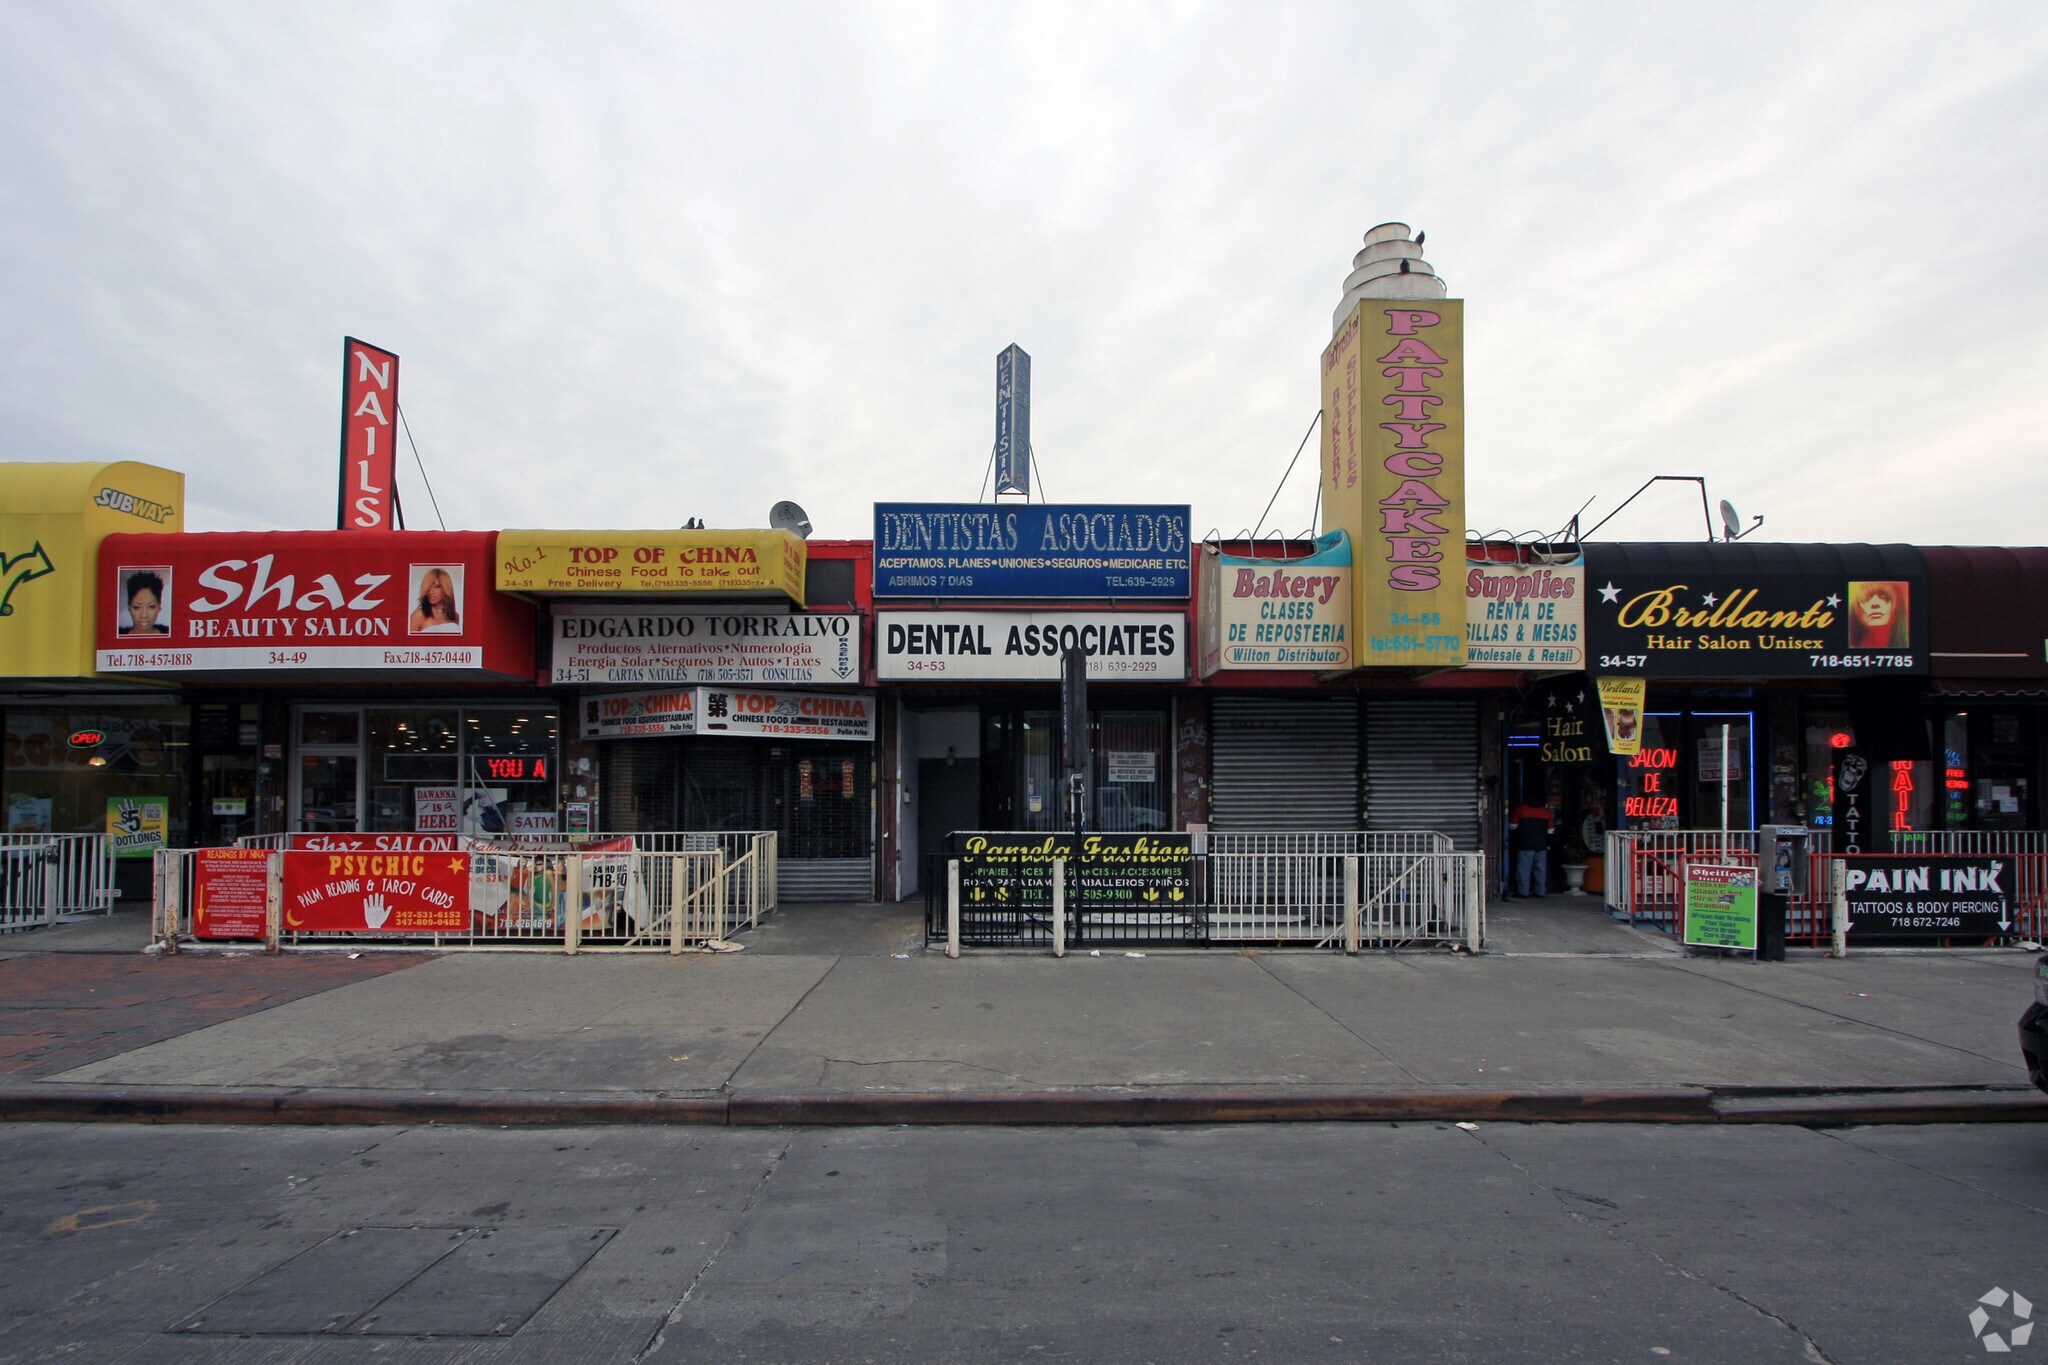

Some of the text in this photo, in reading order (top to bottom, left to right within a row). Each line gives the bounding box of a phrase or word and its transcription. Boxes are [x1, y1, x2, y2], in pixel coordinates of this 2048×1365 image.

[998, 350, 1011, 487] DENTISTA
[1346, 353, 1358, 489] SUPPLIES
[353, 350, 390, 528] NAILS
[1331, 386, 1341, 491] BAKERY
[1377, 309, 1450, 591] PATTYCAKES
[94, 487, 174, 524] SUBWAY
[881, 512, 1184, 552] DENTISTAS ASOCIADOS
[569, 547, 757, 564] TOP OF CHINA
[567, 566, 761, 577] Chinese Food To take out
[948, 558, 991, 569] PLANES
[998, 558, 1045, 569] UNIONES
[1051, 558, 1102, 569] SEGUROS
[1109, 558, 1163, 570] MEDICARE
[1165, 559, 1189, 570] ETC.
[188, 553, 392, 612] Shaz
[504, 579, 534, 588] 34-51
[548, 579, 623, 589] Free Delivery
[889, 575, 973, 587] ABRIMOS 7 DIAS
[1233, 568, 1341, 605] Bakery
[1466, 569, 1575, 603] Supplies
[1260, 601, 1314, 620] CLASES
[1486, 601, 1554, 621] RENTA DE
[1616, 585, 1836, 629] Brillanti
[188, 617, 392, 638] BEAUTY SALON
[561, 616, 850, 639] EDGARDO TORRALVO
[1228, 623, 1345, 642] DE REPOSTERIA
[1466, 622, 1578, 642] SILLAS & MESAS
[887, 624, 1176, 657] DENTAL ASSOCIATES
[1646, 634, 1824, 650] Hair Salon Unisex
[577, 643, 812, 655] Productos Alternativos Numerologia
[1233, 647, 1270, 663] Wilton
[1276, 647, 1341, 663] Distributor
[1467, 647, 1522, 663] Wholesale
[1528, 650, 1536, 662] &
[1540, 648, 1574, 663] Retail
[269, 651, 307, 666] 34-49
[568, 656, 822, 669] Energia Solar Seguros De Autos Taxes
[906, 660, 946, 671] 34-53
[1107, 661, 1158, 672] 639-2929
[1599, 655, 1648, 668] 34-57
[1809, 654, 1913, 668] 718-651-7785
[556, 668, 812, 682] 34-51 CARTAS NATALES (718) 505-3571 CONSULTAS
[602, 692, 692, 717] TOP CHINA
[735, 693, 866, 718] TOP CHINA
[601, 717, 621, 726] CHINESE
[622, 717, 637, 726] FOOD
[620, 724, 665, 734] 718-335-5556
[731, 714, 764, 723] CHINESE
[766, 716, 789, 724] FOOD
[821, 718, 868, 728] RESTAURANT
[1547, 716, 1584, 737] Hair
[762, 724, 829, 735] 718-335-5556
[837, 728, 852, 736] Pollo
[71, 732, 102, 745] OPEN
[1541, 740, 1593, 763] Salon
[1628, 748, 1677, 769] SALON
[487, 758, 546, 778] YOU A
[1643, 772, 1661, 794] DE
[416, 789, 457, 800] DAWANNA
[432, 803, 442, 813] IS
[1625, 797, 1679, 817] BELLEZA
[121, 809, 141, 832] $5
[418, 814, 458, 829] HERE
[514, 816, 555, 829] $ATM
[116, 831, 162, 847] OOTLONGS
[375, 835, 452, 850] SALON
[206, 850, 237, 859] READINGS
[239, 850, 248, 859] BY
[963, 836, 1191, 863] Pamela Fashion
[329, 854, 425, 876] PSYCHIC
[1121, 867, 1182, 876] ACCESSORIES
[1028, 878, 1067, 886] DAMS
[1847, 864, 2004, 894] PAIN INK
[297, 878, 455, 909] PALM READING & TAROT CARDS
[1083, 889, 1133, 900] 505-9300
[395, 911, 461, 919] 347-531-6153
[1851, 902, 1999, 914] TATTOOS & BODY PIERCING
[395, 918, 461, 926] 347-809-0482
[1891, 917, 1961, 927] 718 672-7246
